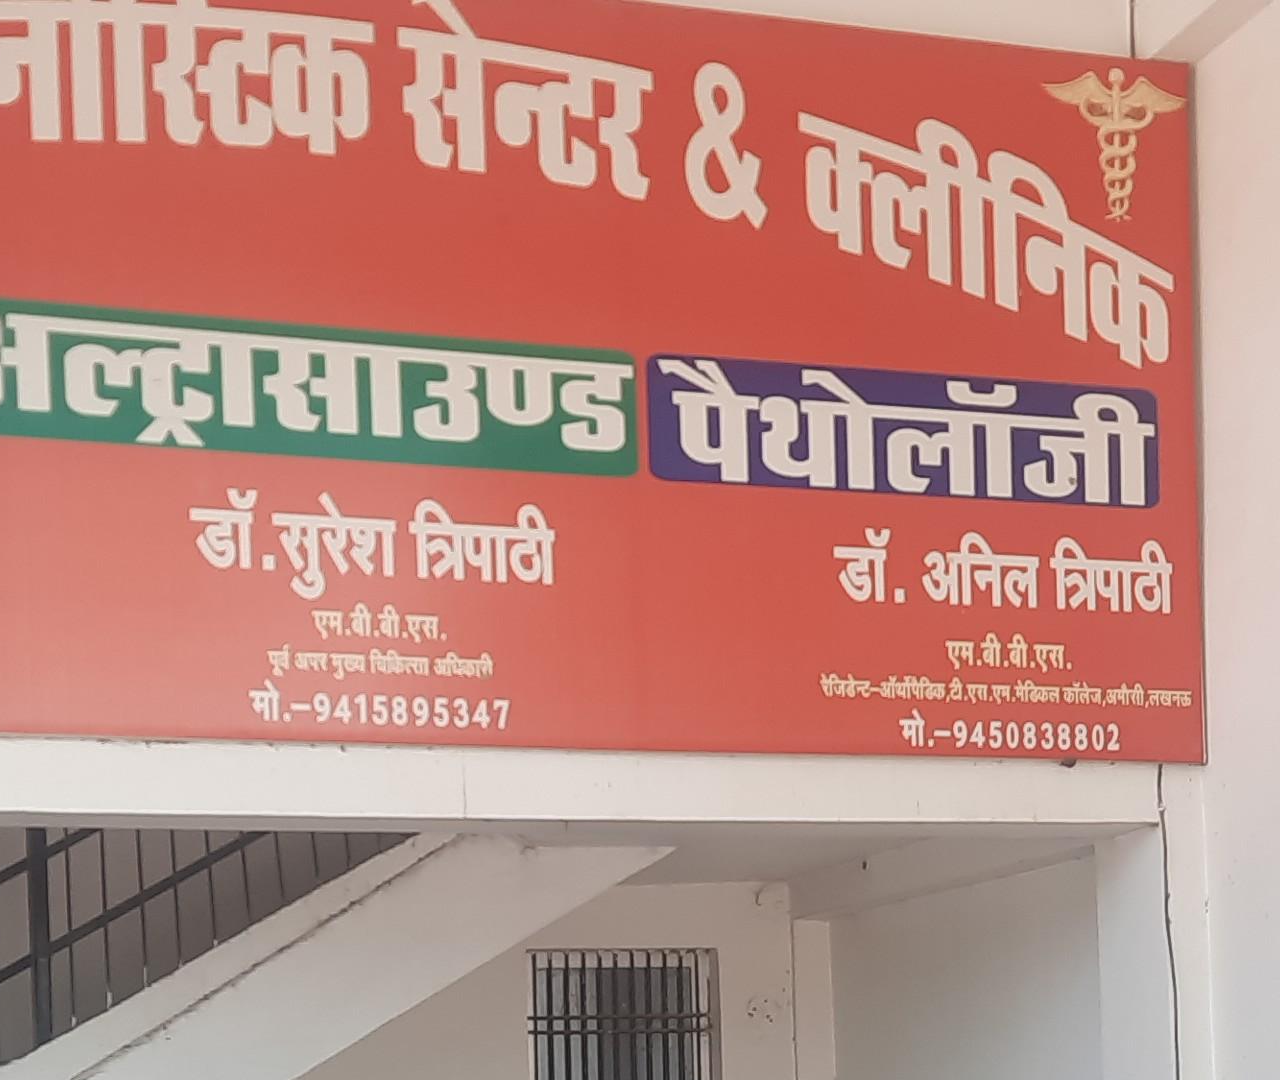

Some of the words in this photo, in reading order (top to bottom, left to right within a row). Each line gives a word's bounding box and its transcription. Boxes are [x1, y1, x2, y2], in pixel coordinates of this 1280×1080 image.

[396, 0, 654, 201] सेन्टर
[685, 61, 769, 230] &
[797, 117, 1175, 370] क्लीनिक
[657, 357, 1156, 508] पैथोलॉजी
[409, 499, 556, 586] त्रिपाठी
[832, 527, 907, 605] डॉ.
[921, 531, 1040, 609] अनिल
[1050, 536, 1173, 615] त्रिपाठी
[294, 652, 329, 674] अपर
